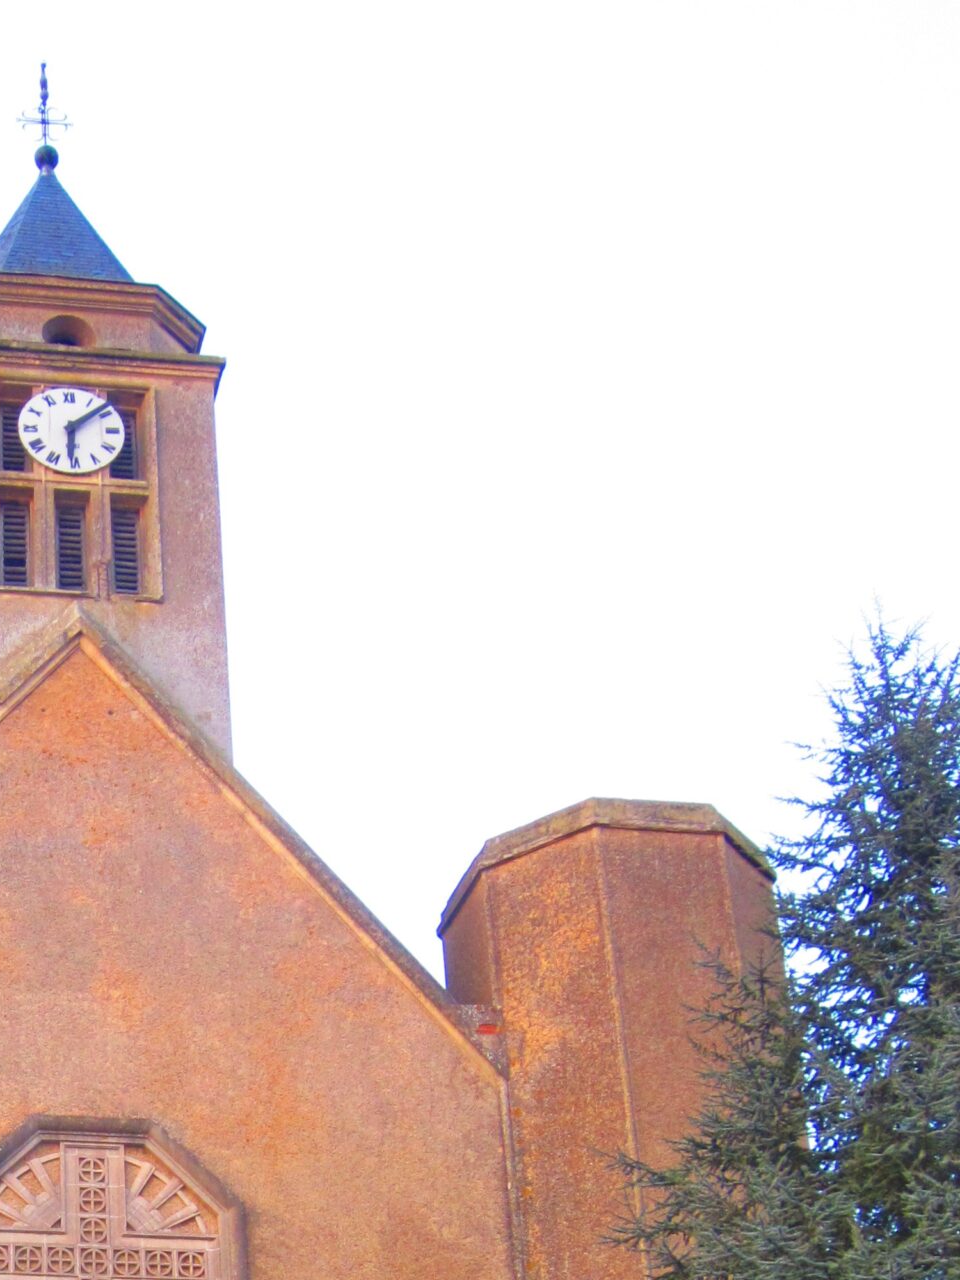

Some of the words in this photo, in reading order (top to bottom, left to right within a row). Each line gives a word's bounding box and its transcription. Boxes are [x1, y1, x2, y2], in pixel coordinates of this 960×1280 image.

[42, 395, 56, 407] XI
[63, 392, 75, 403] XII
[28, 407, 42, 417] X
[23, 424, 38, 432] IX
[46, 451, 61, 465] VII
[90, 453, 101, 465] V
